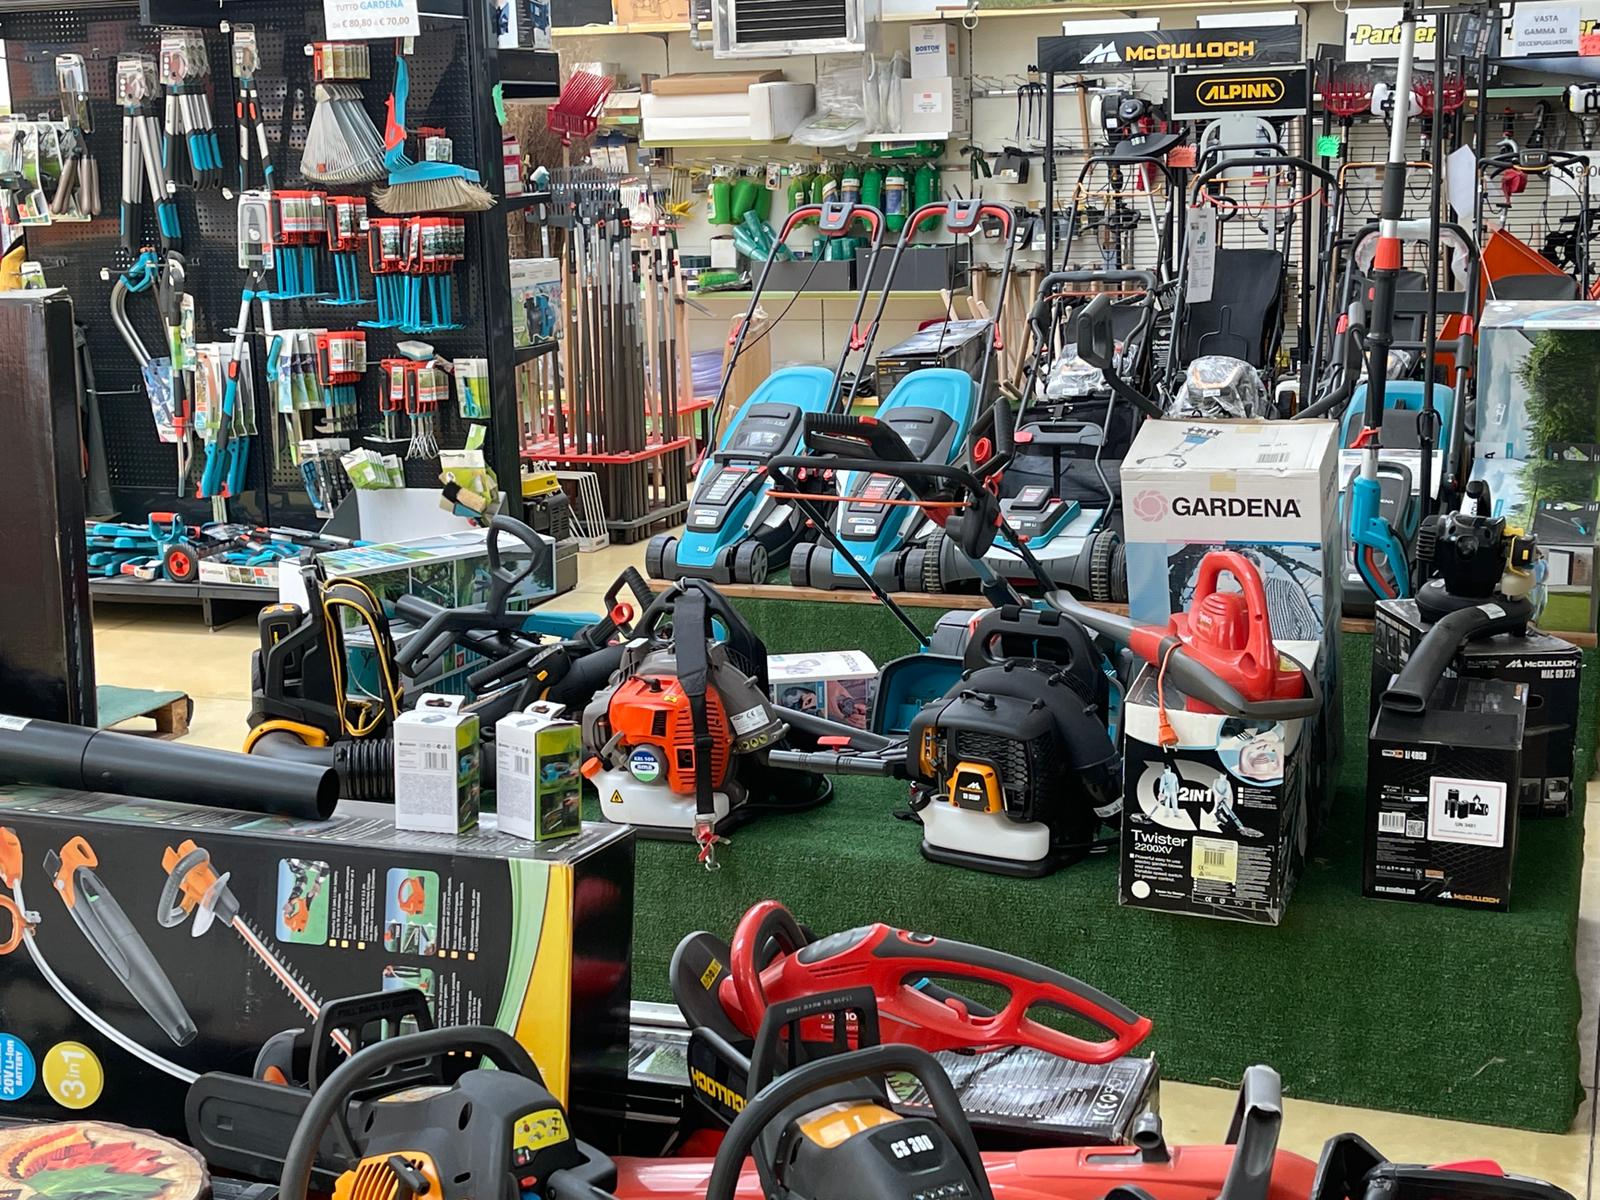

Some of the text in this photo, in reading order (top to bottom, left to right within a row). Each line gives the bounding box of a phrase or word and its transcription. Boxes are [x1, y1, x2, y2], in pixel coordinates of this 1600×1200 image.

[336, 0, 404, 12] TUTTO GARDENA
[342, 20, 348, 28] €
[349, 19, 373, 28] 80,80
[380, 17, 386, 26] €
[386, 16, 410, 26] 70,00
[1534, 15, 1559, 23] VASTA
[1354, 24, 1436, 46] Parter
[1524, 28, 1556, 36] GAMMA
[914, 44, 940, 53] BOSTON
[1125, 41, 1255, 62] McCULLOCH
[1518, 39, 1574, 48] DECESPUGLIATORI
[1204, 82, 1276, 101] ALPINA
[1171, 496, 1301, 518] GARDENA
[1523, 659, 1577, 668] McCULLOCH
[1178, 786, 1213, 803] 2IN1
[1130, 828, 1188, 848] Twister
[1134, 842, 1173, 855] 2200XV
[1453, 893, 1500, 904] McCULLOCH
[15, 1050, 23, 1087] BATTERY
[3, 1069, 15, 1096] 20V
[691, 1066, 748, 1114] CULLOCH
[890, 1139, 912, 1159] CS
